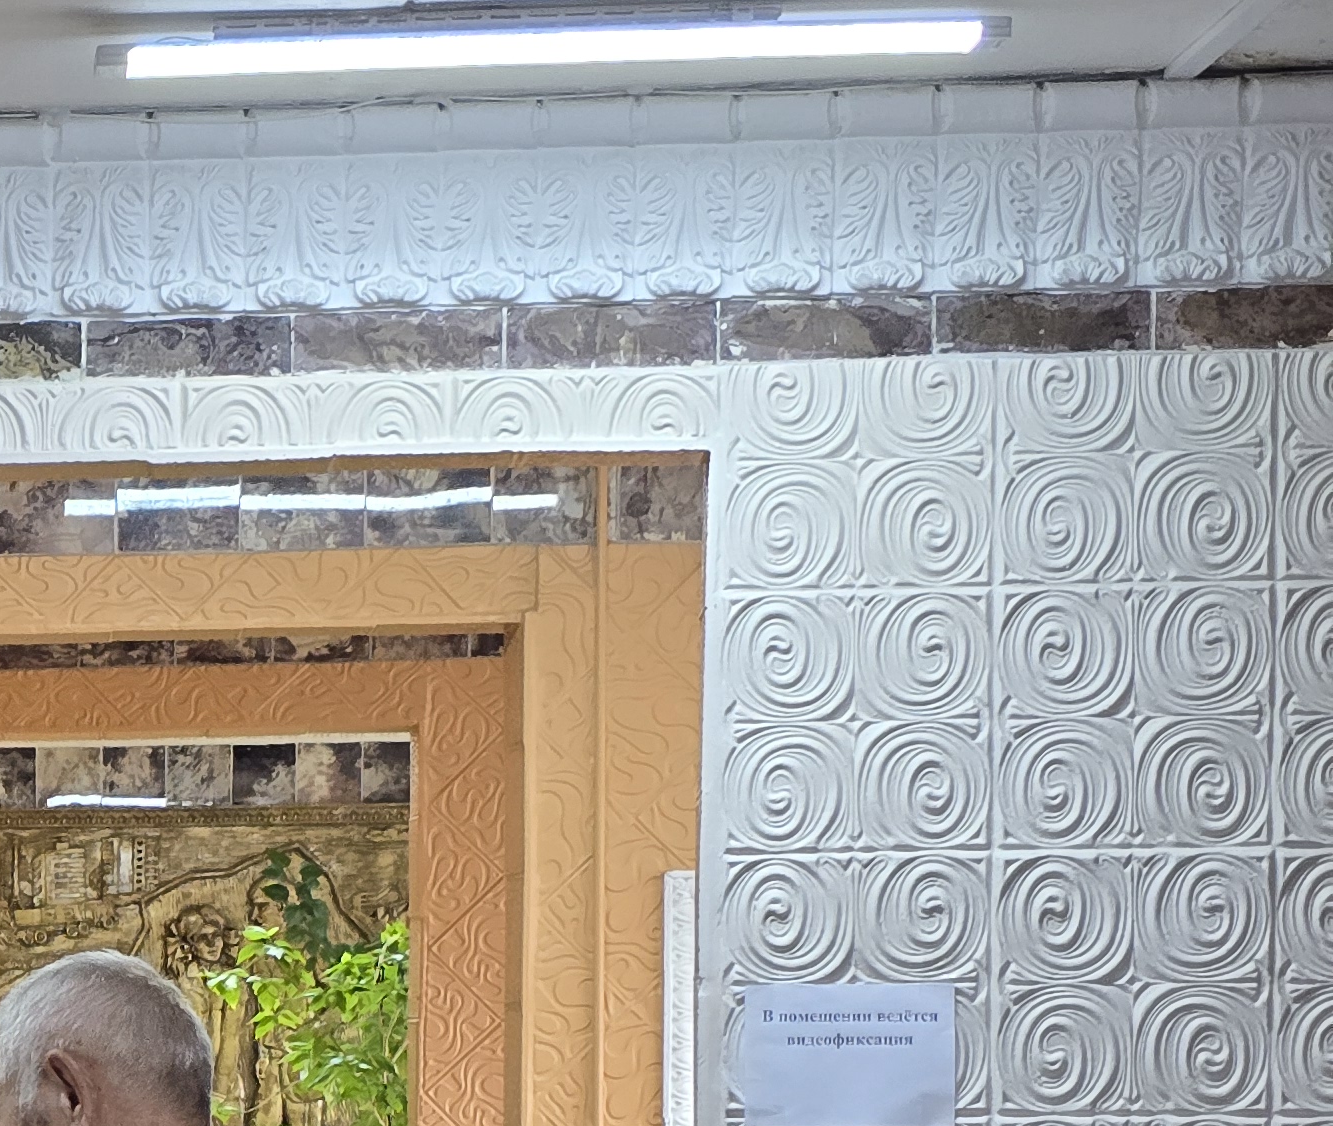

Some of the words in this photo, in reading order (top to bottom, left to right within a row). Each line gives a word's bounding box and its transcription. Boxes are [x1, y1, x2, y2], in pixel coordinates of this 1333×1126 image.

[762, 1009, 774, 1023] В
[778, 1011, 872, 1025] помещении
[877, 1009, 939, 1024] ведётся
[786, 1033, 914, 1049] видеофиксация
